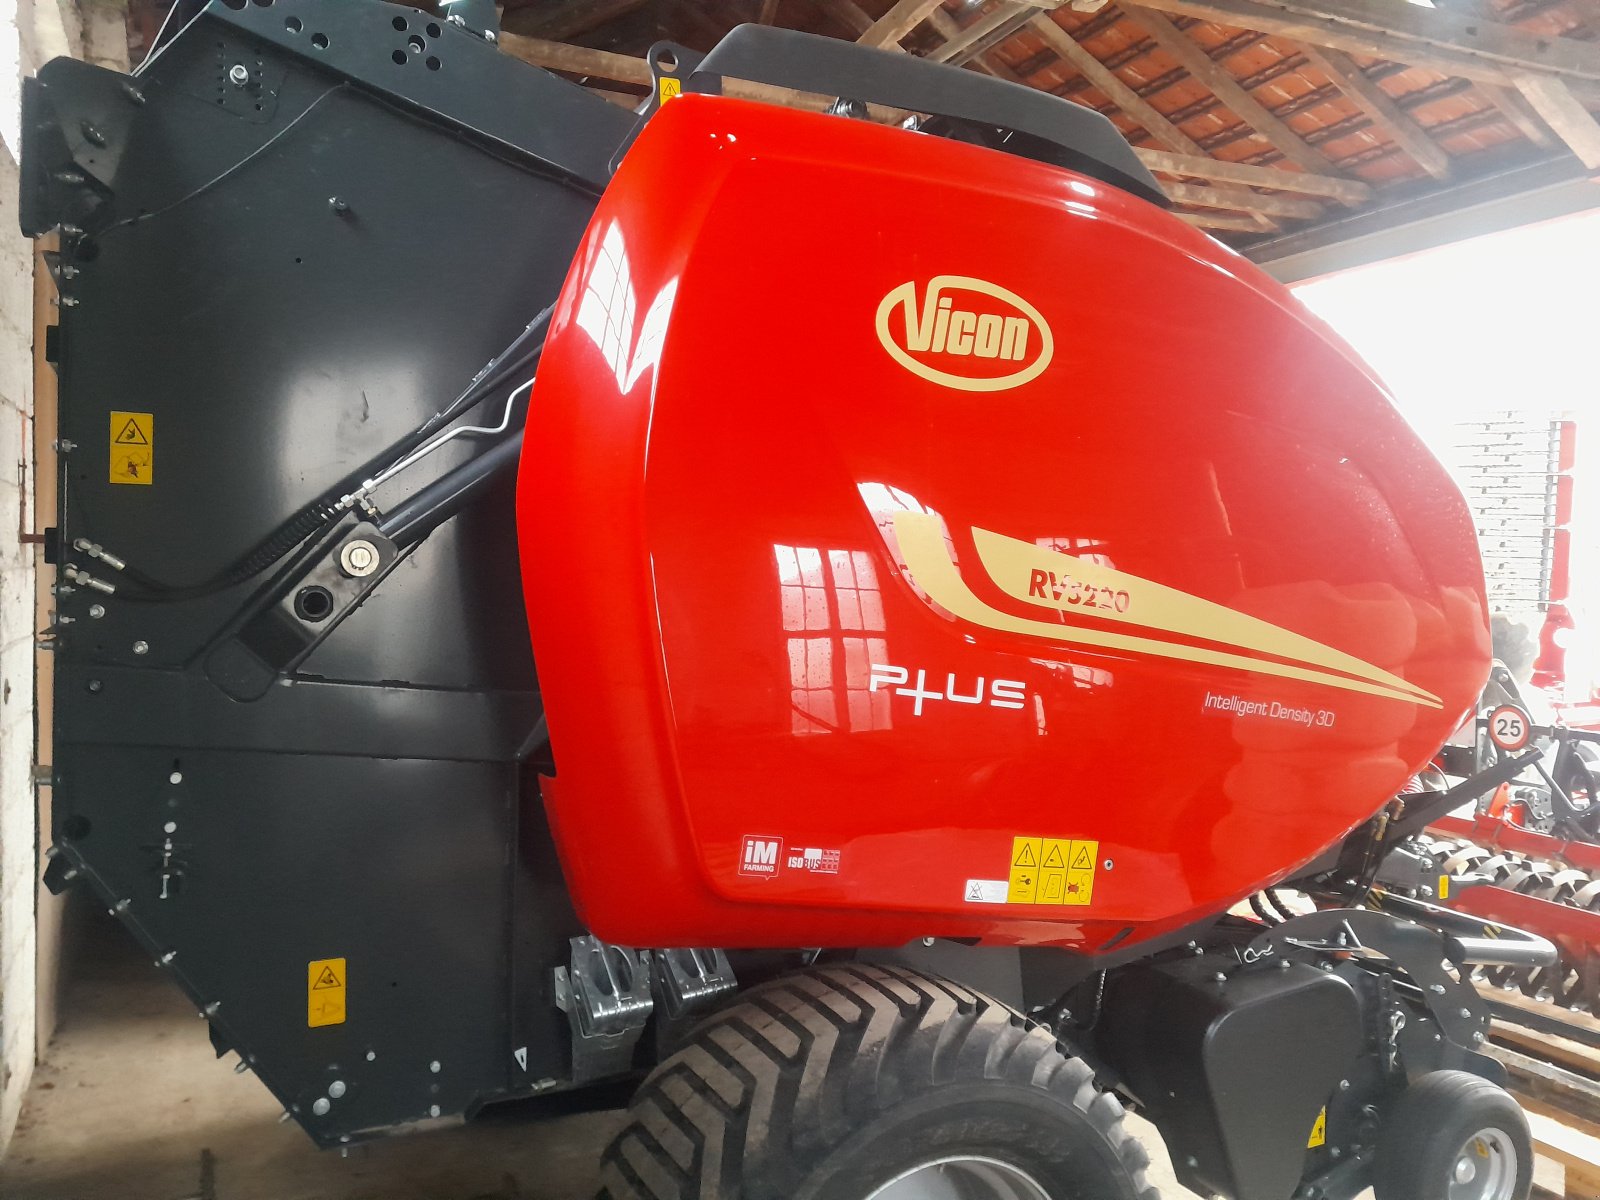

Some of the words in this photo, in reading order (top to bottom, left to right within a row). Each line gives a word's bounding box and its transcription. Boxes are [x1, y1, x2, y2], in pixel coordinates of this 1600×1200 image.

[902, 275, 1030, 361] Vicon
[1205, 691, 1268, 717] Intelligent
[1269, 702, 1315, 727] Density
[1316, 710, 1335, 727] 3D
[1497, 719, 1521, 737] 25
[744, 841, 778, 865] iM
[743, 864, 775, 873] FARMING
